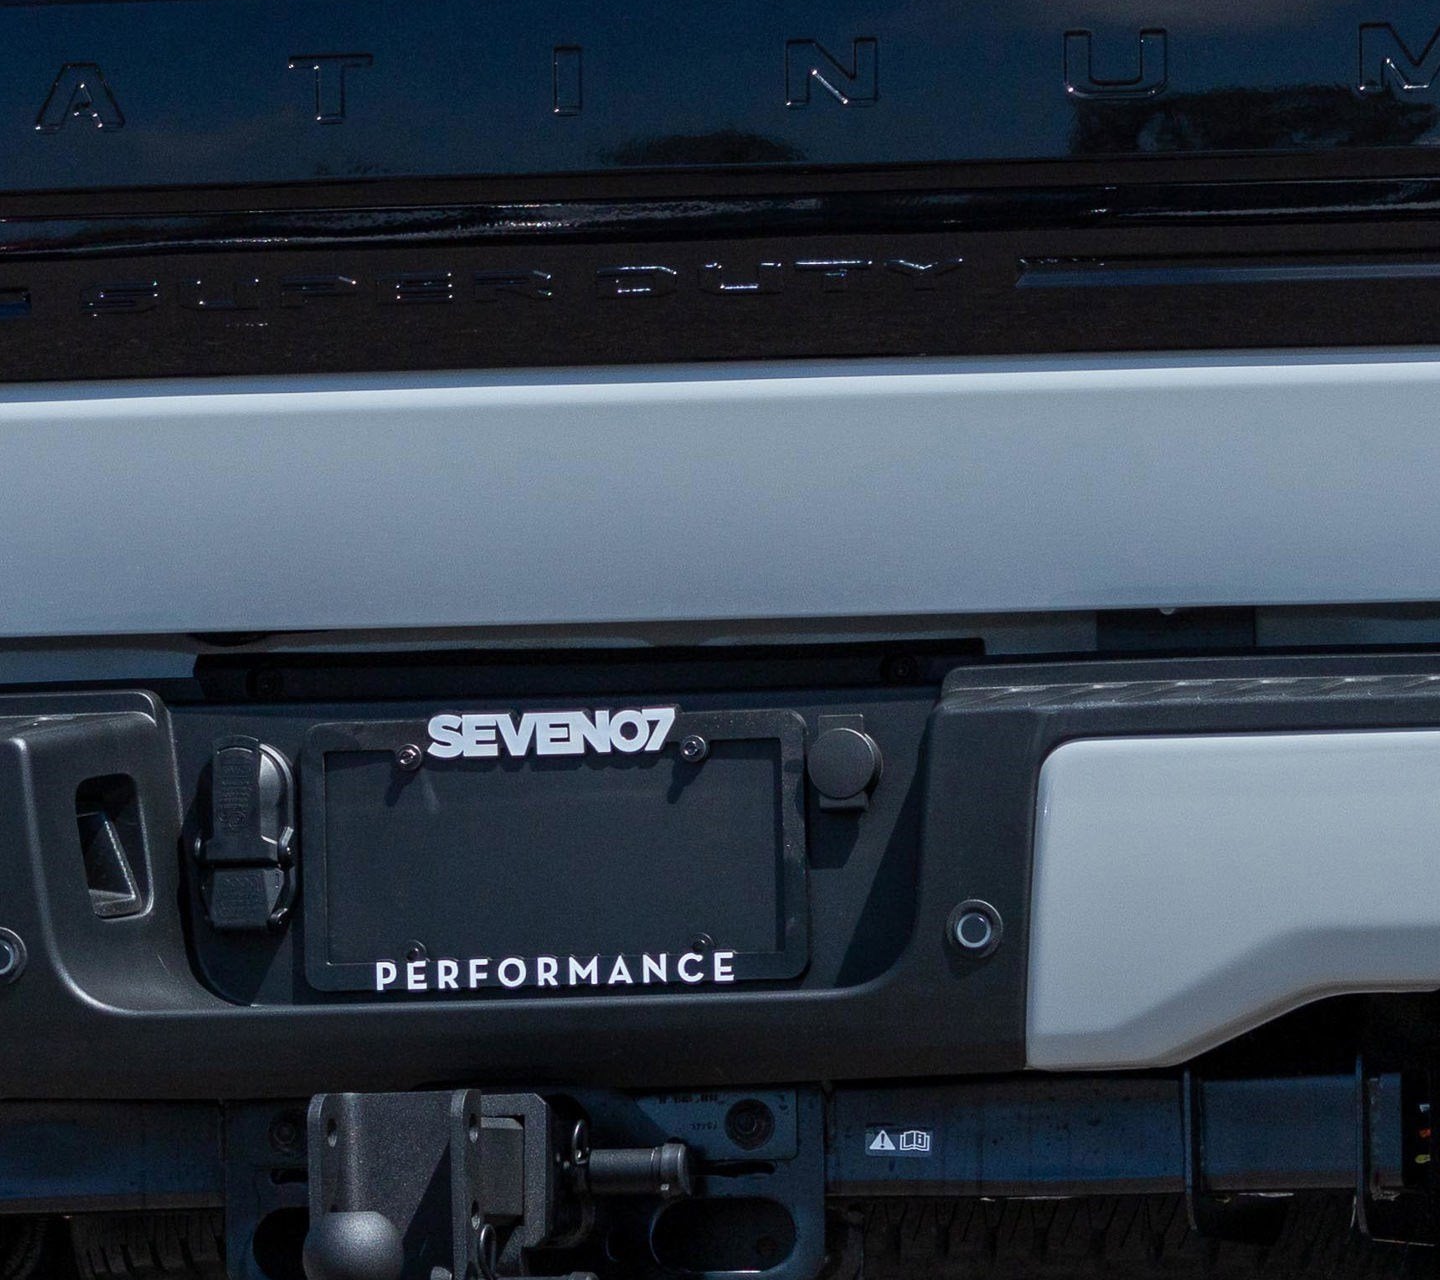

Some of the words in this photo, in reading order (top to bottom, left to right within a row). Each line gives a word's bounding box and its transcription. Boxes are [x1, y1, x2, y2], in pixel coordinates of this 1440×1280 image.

[79, 267, 553, 318] SUPER
[594, 257, 965, 299] DUTY
[375, 950, 737, 992] PERFORMANCE
